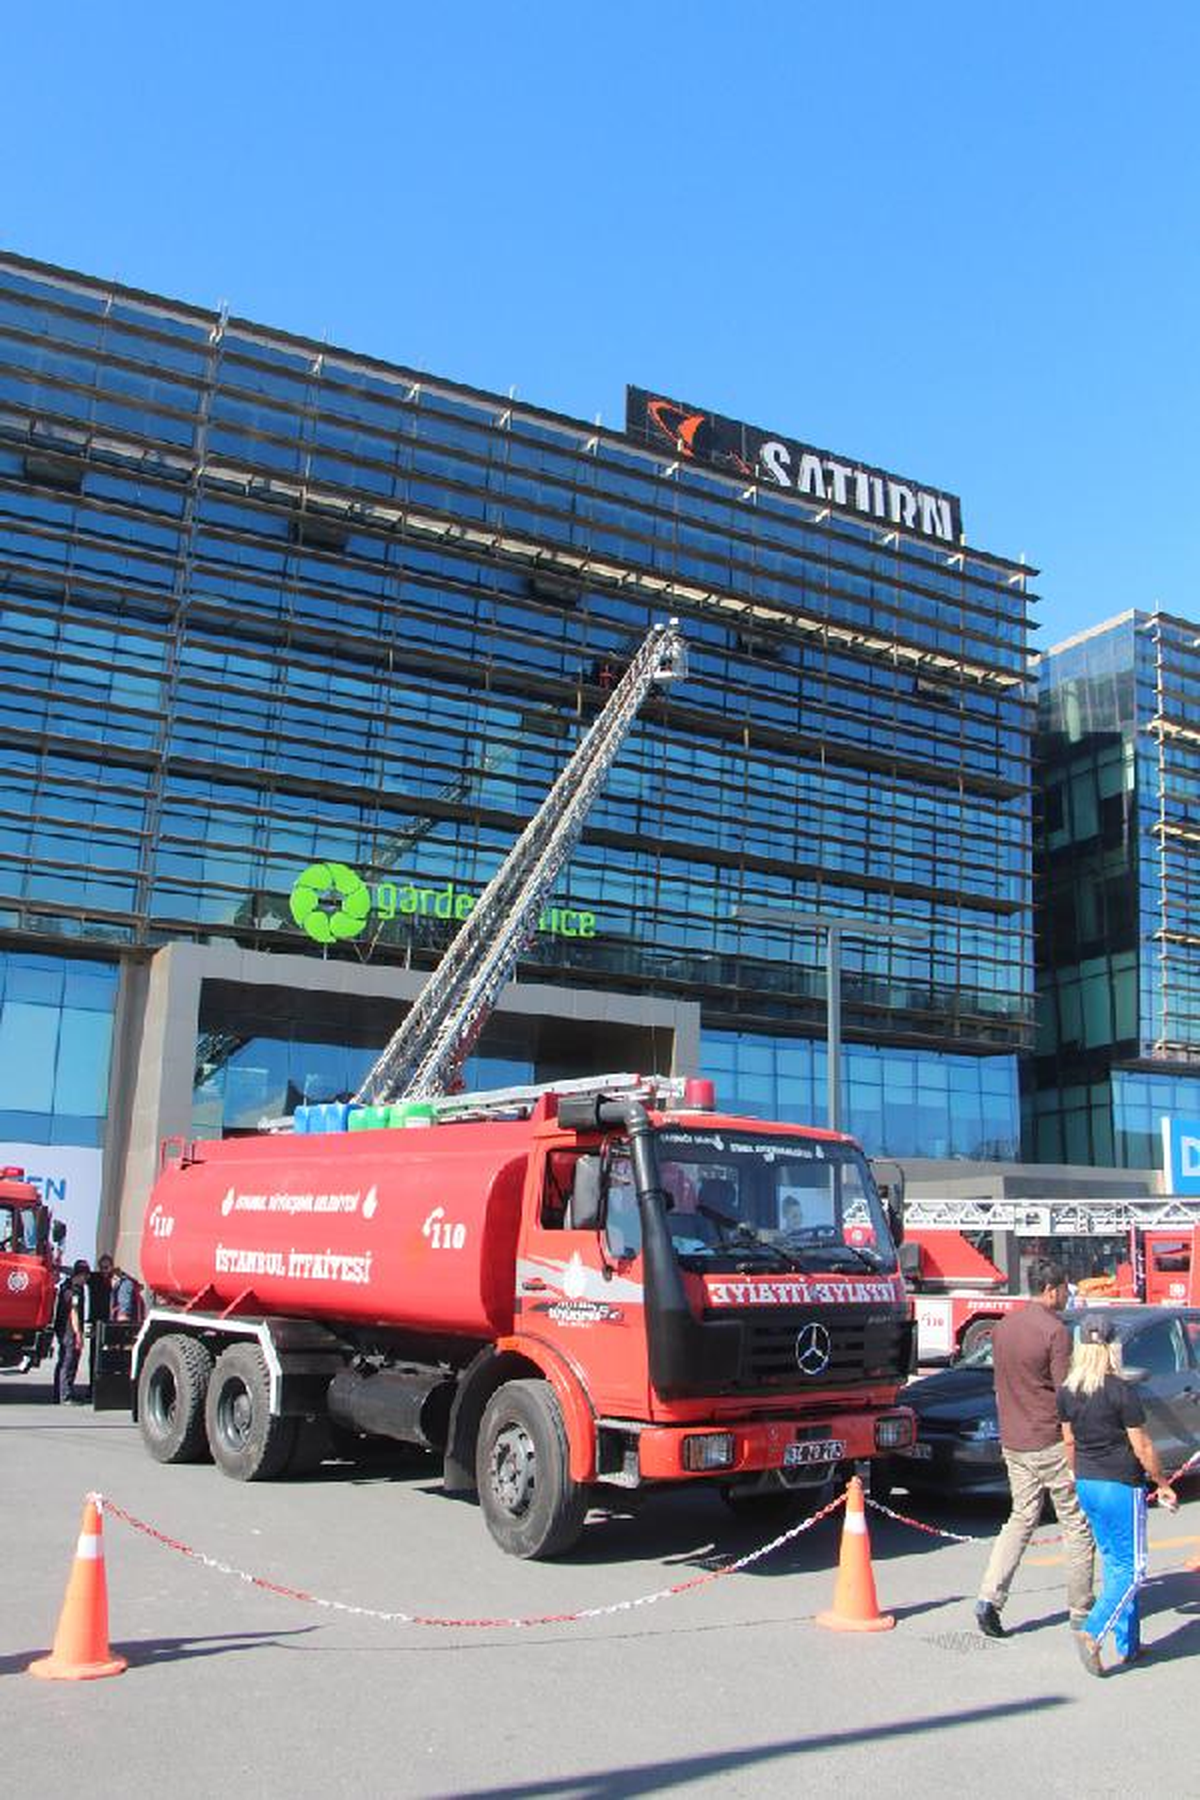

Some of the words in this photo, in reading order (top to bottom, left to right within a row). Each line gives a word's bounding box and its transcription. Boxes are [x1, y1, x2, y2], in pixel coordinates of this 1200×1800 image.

[760, 441, 954, 541] SATURN
[153, 1216, 175, 1237] 110
[430, 1222, 466, 1249] 110
